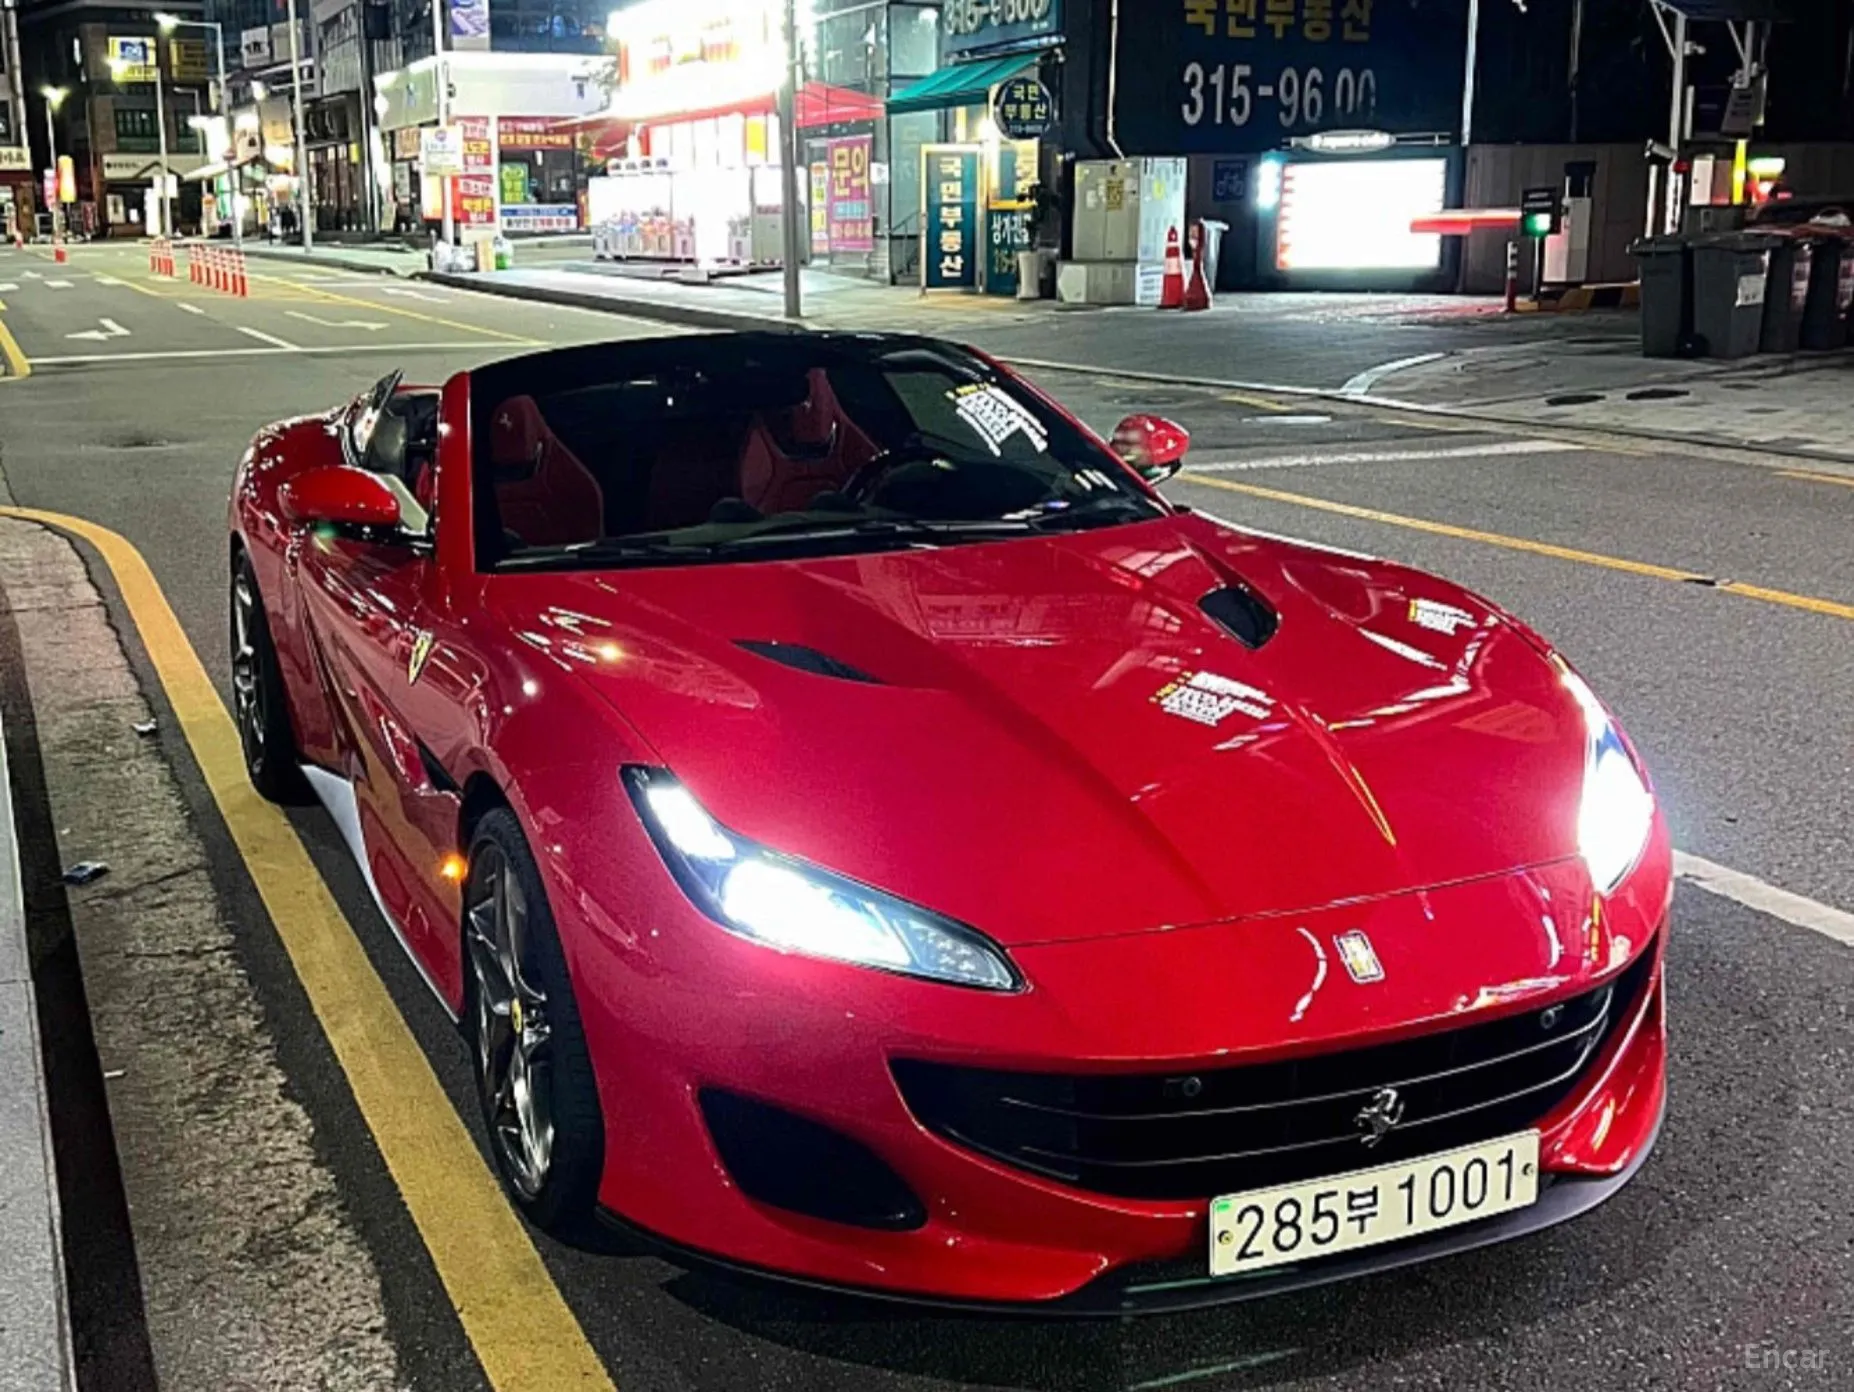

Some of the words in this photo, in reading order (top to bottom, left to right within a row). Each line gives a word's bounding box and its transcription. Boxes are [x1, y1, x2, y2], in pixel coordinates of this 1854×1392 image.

[1183, 0, 1374, 41] 국민부동산
[832, 143, 870, 197] 문의
[939, 156, 963, 277] 국민부동산
[1235, 1185, 1379, 1262] 285부
[1398, 1148, 1514, 1226] 1001
